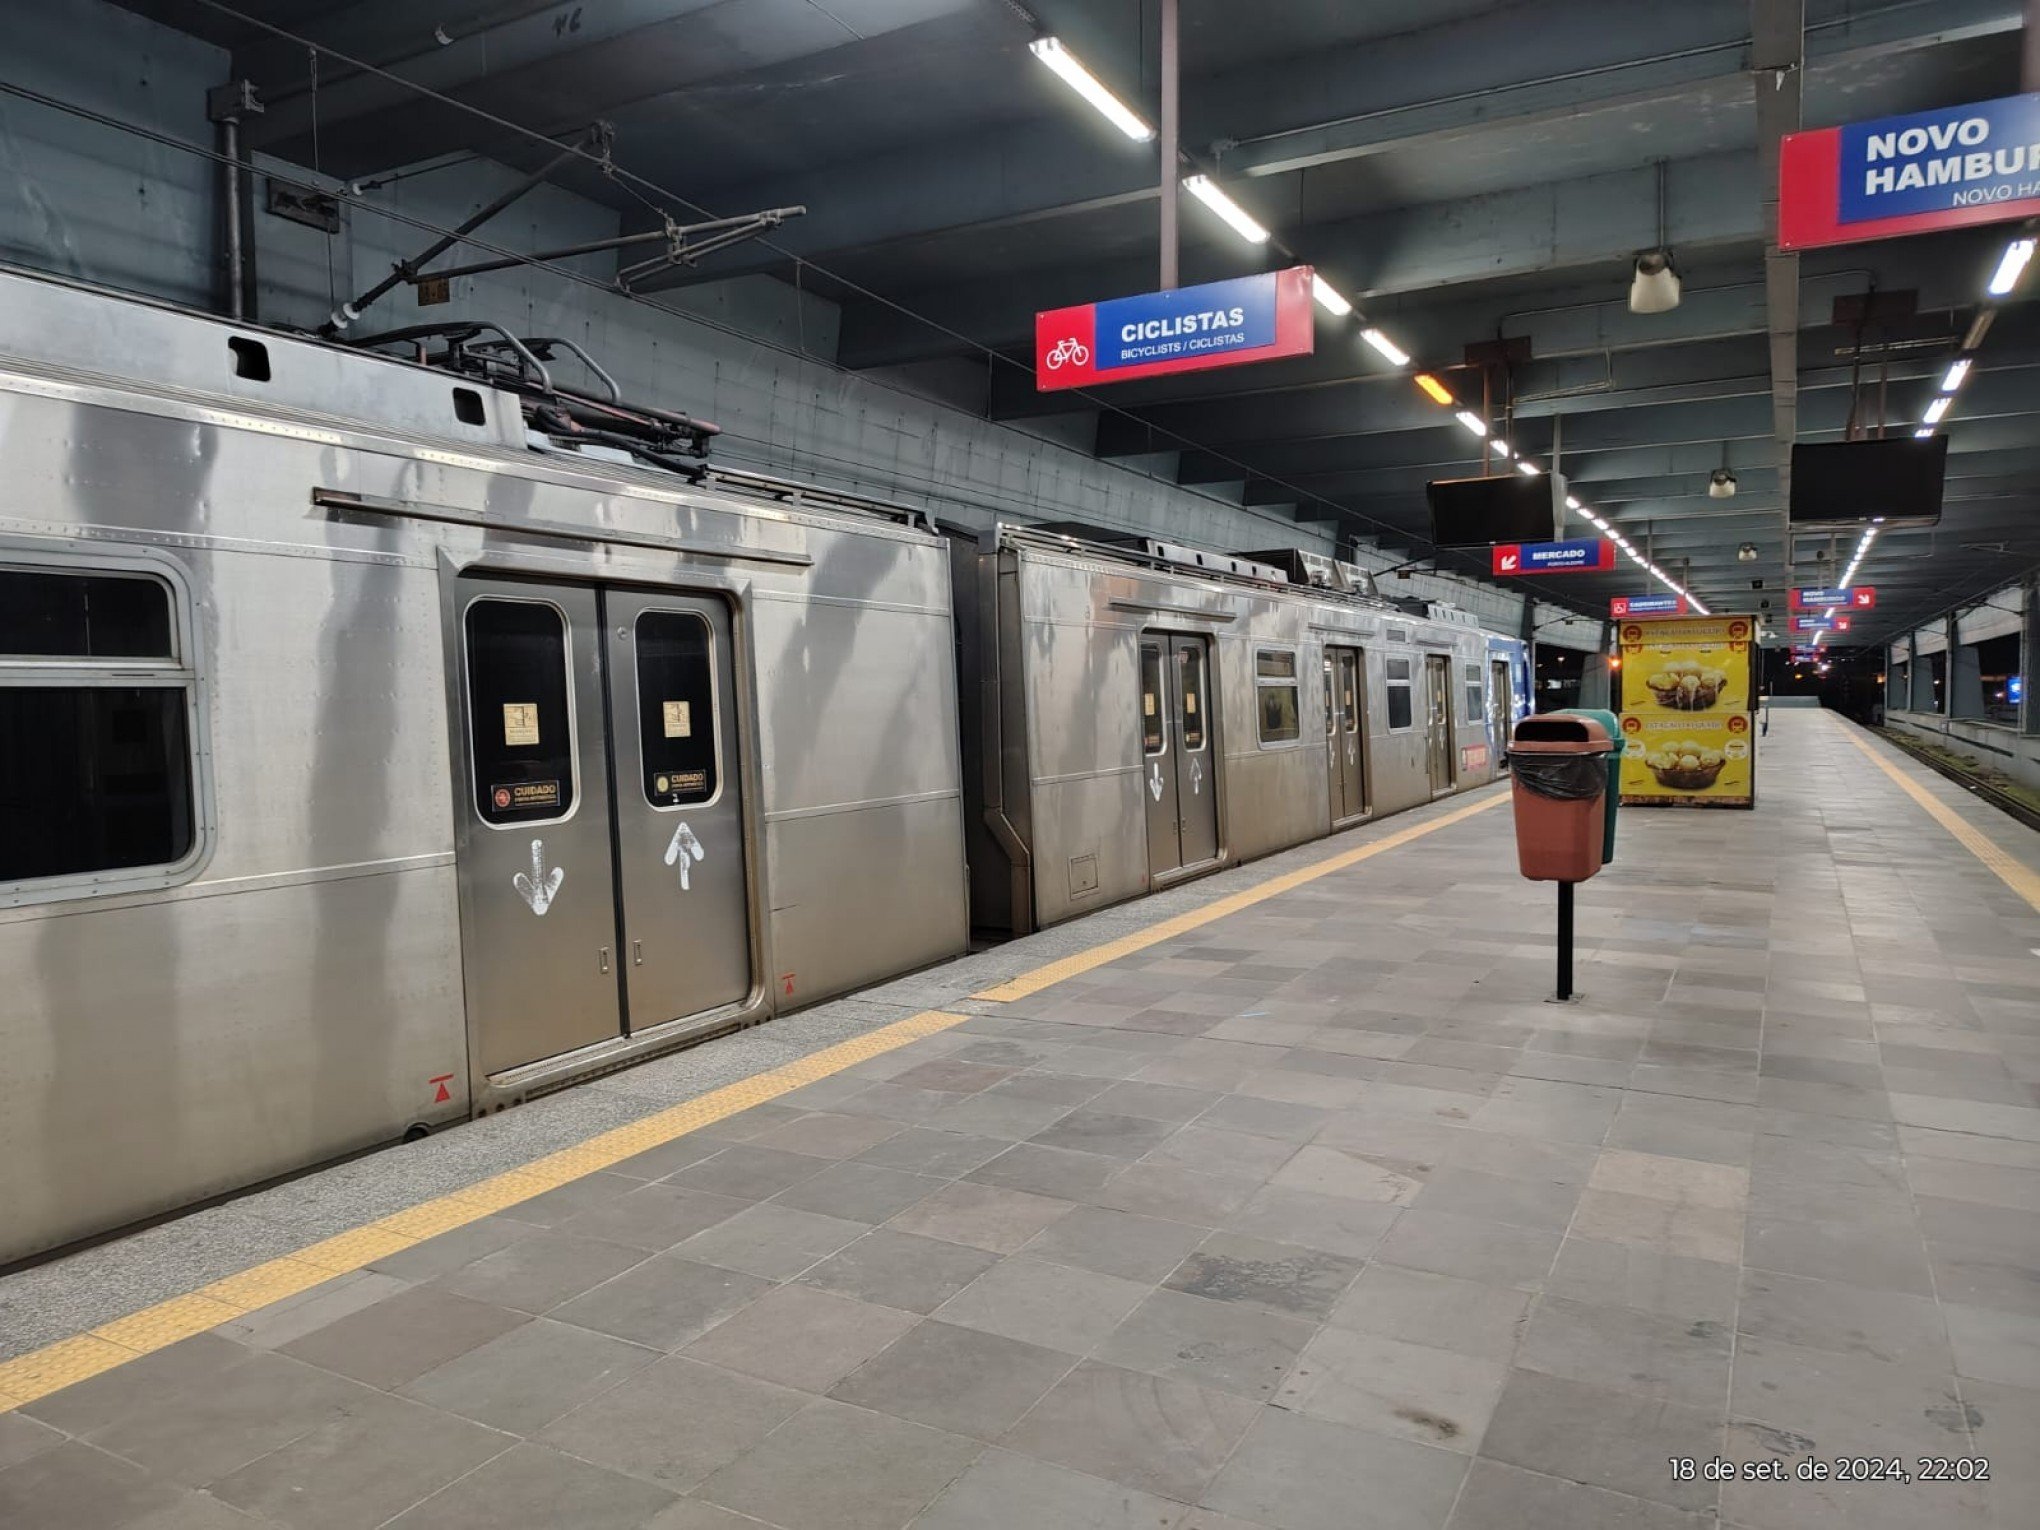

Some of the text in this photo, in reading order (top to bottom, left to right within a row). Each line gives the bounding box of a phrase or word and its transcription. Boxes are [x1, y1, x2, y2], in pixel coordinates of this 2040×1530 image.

[1867, 117, 1990, 162] NOVO
[1952, 184, 2012, 206] NOVO
[1121, 307, 1244, 342] CICLISTAS
[1121, 341, 1181, 359] BICYCLISTS
[1188, 332, 1245, 350] CICLISTAS
[1532, 549, 1585, 561] MERCADO
[514, 784, 557, 796] CUIDADO
